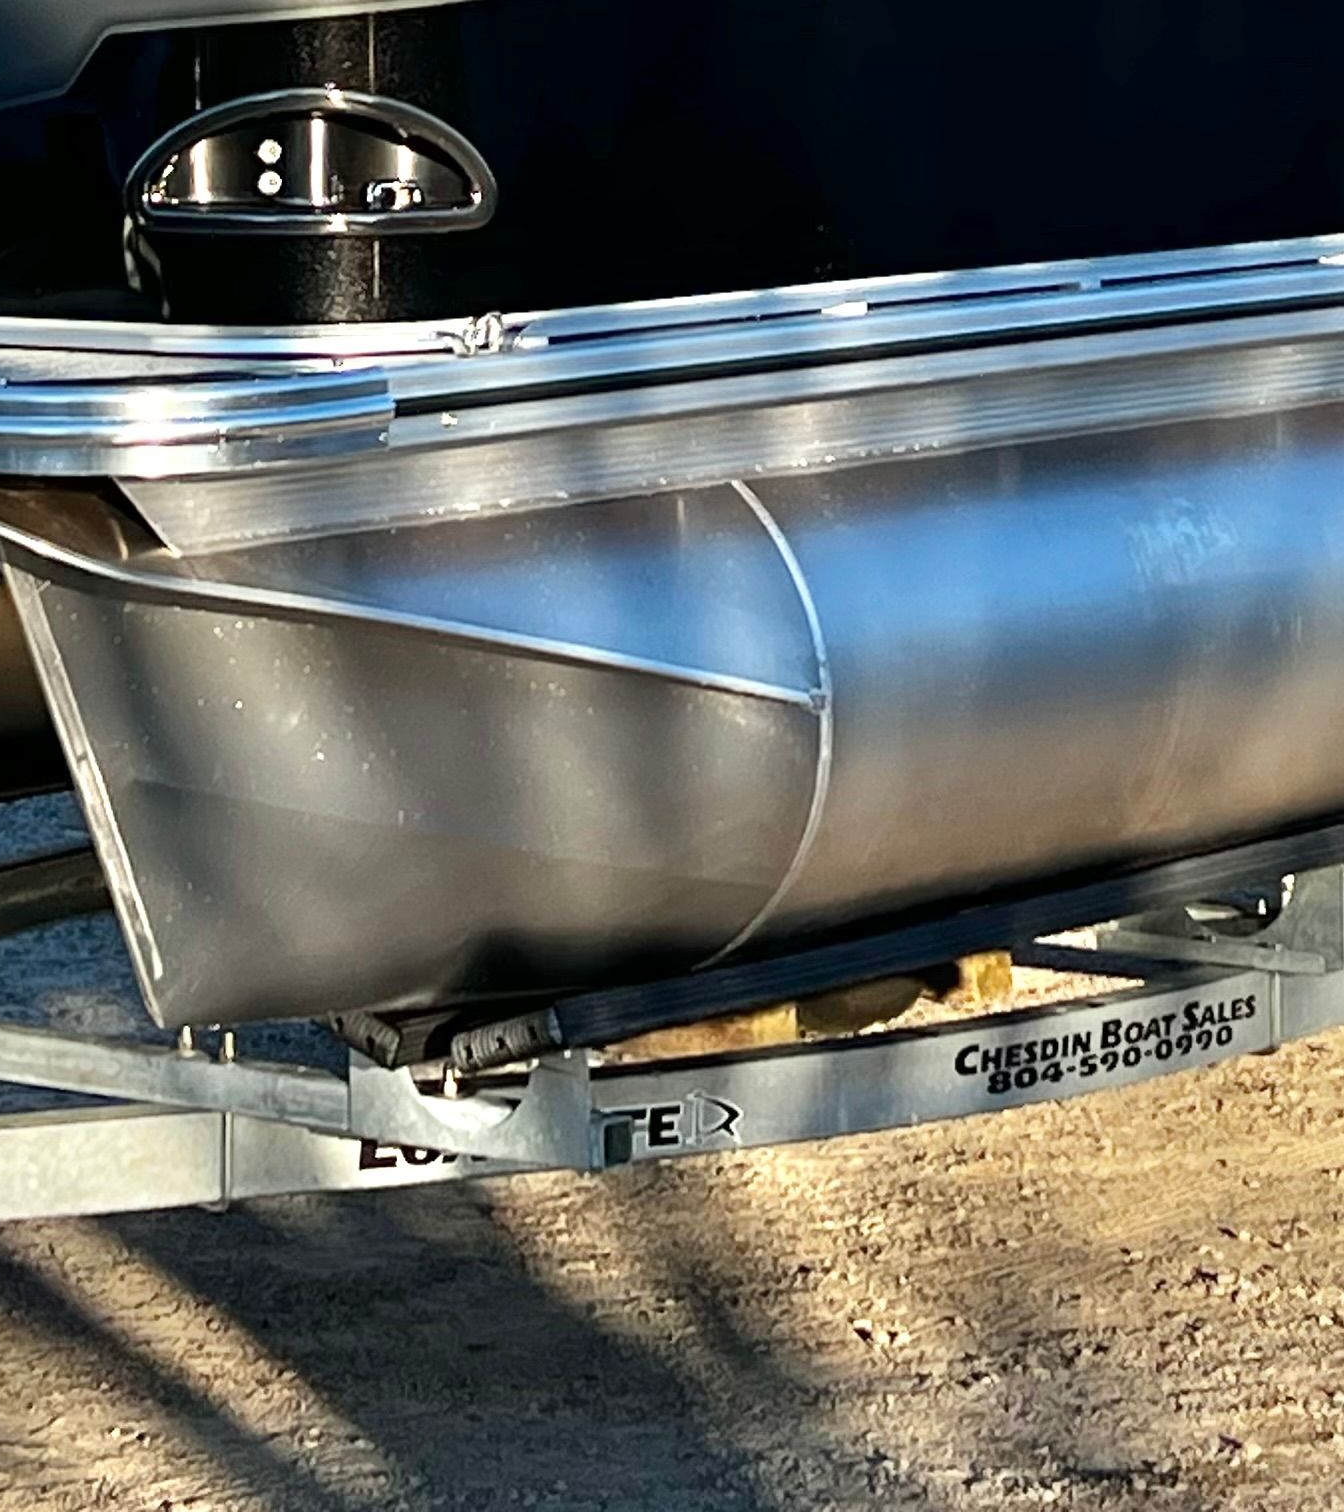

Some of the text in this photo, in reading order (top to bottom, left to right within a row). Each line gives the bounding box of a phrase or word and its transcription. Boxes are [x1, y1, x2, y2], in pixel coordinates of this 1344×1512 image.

[1100, 1013, 1177, 1050] BOAT
[1182, 994, 1257, 1032] SALES
[987, 1025, 1234, 1095] 804-590-0990
